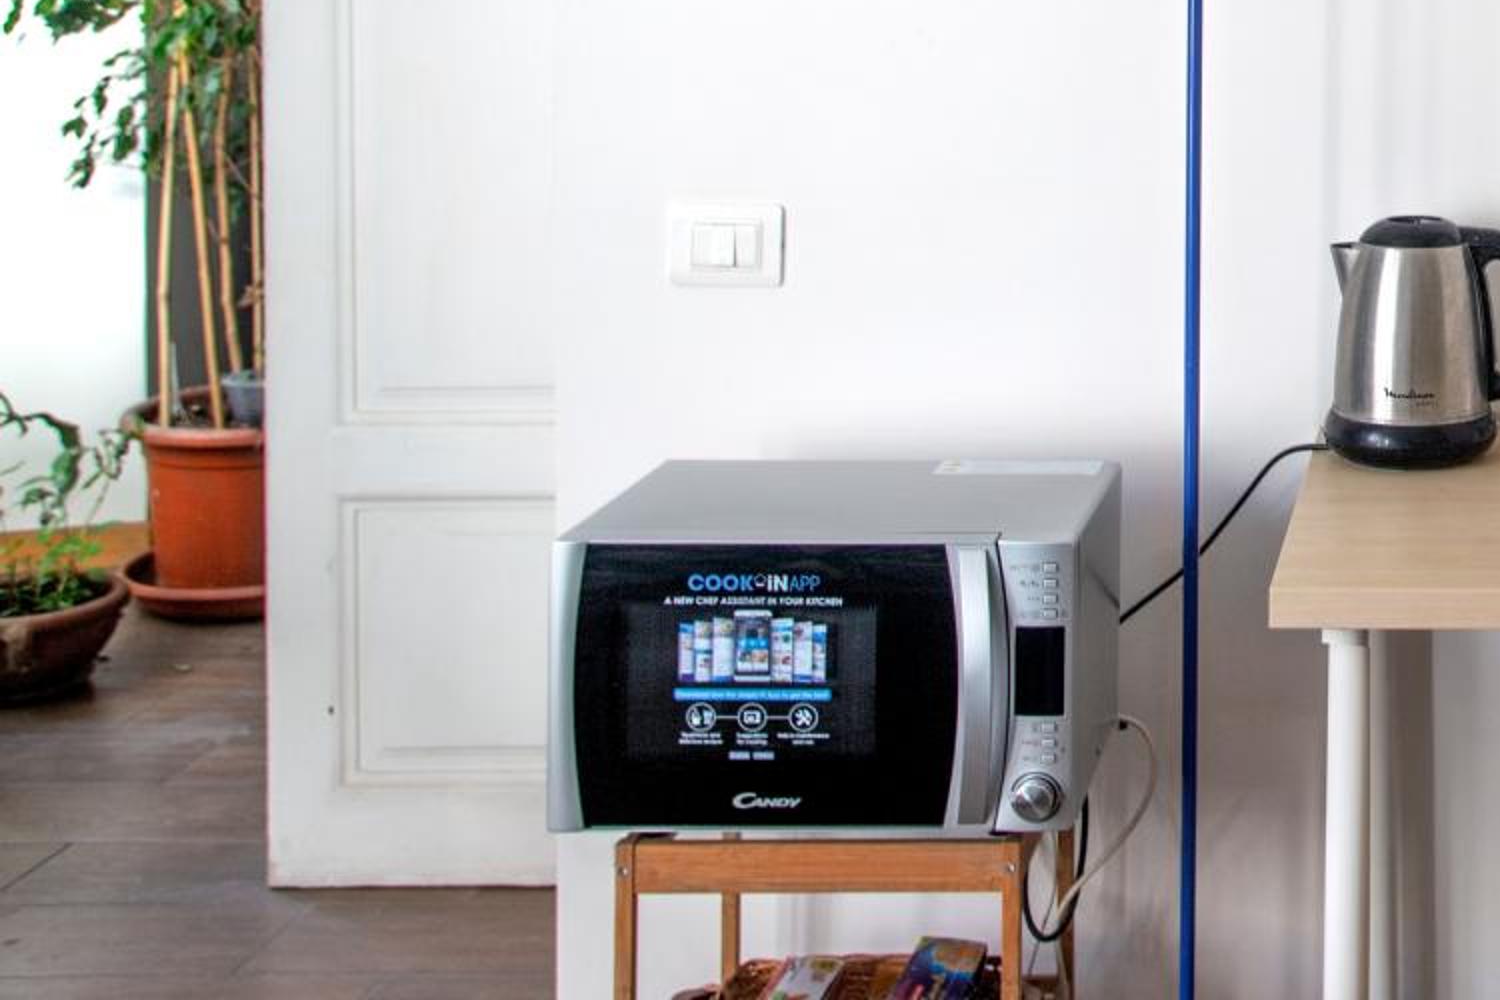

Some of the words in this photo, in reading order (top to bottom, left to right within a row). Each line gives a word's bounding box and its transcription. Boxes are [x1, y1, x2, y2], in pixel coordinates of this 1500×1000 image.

[687, 573, 753, 592] COOK
[663, 597, 672, 605] A
[674, 597, 694, 605] NEW
[696, 596, 718, 605] CHEF
[779, 597, 803, 606] YOUR
[805, 597, 843, 607] KITCHEN
